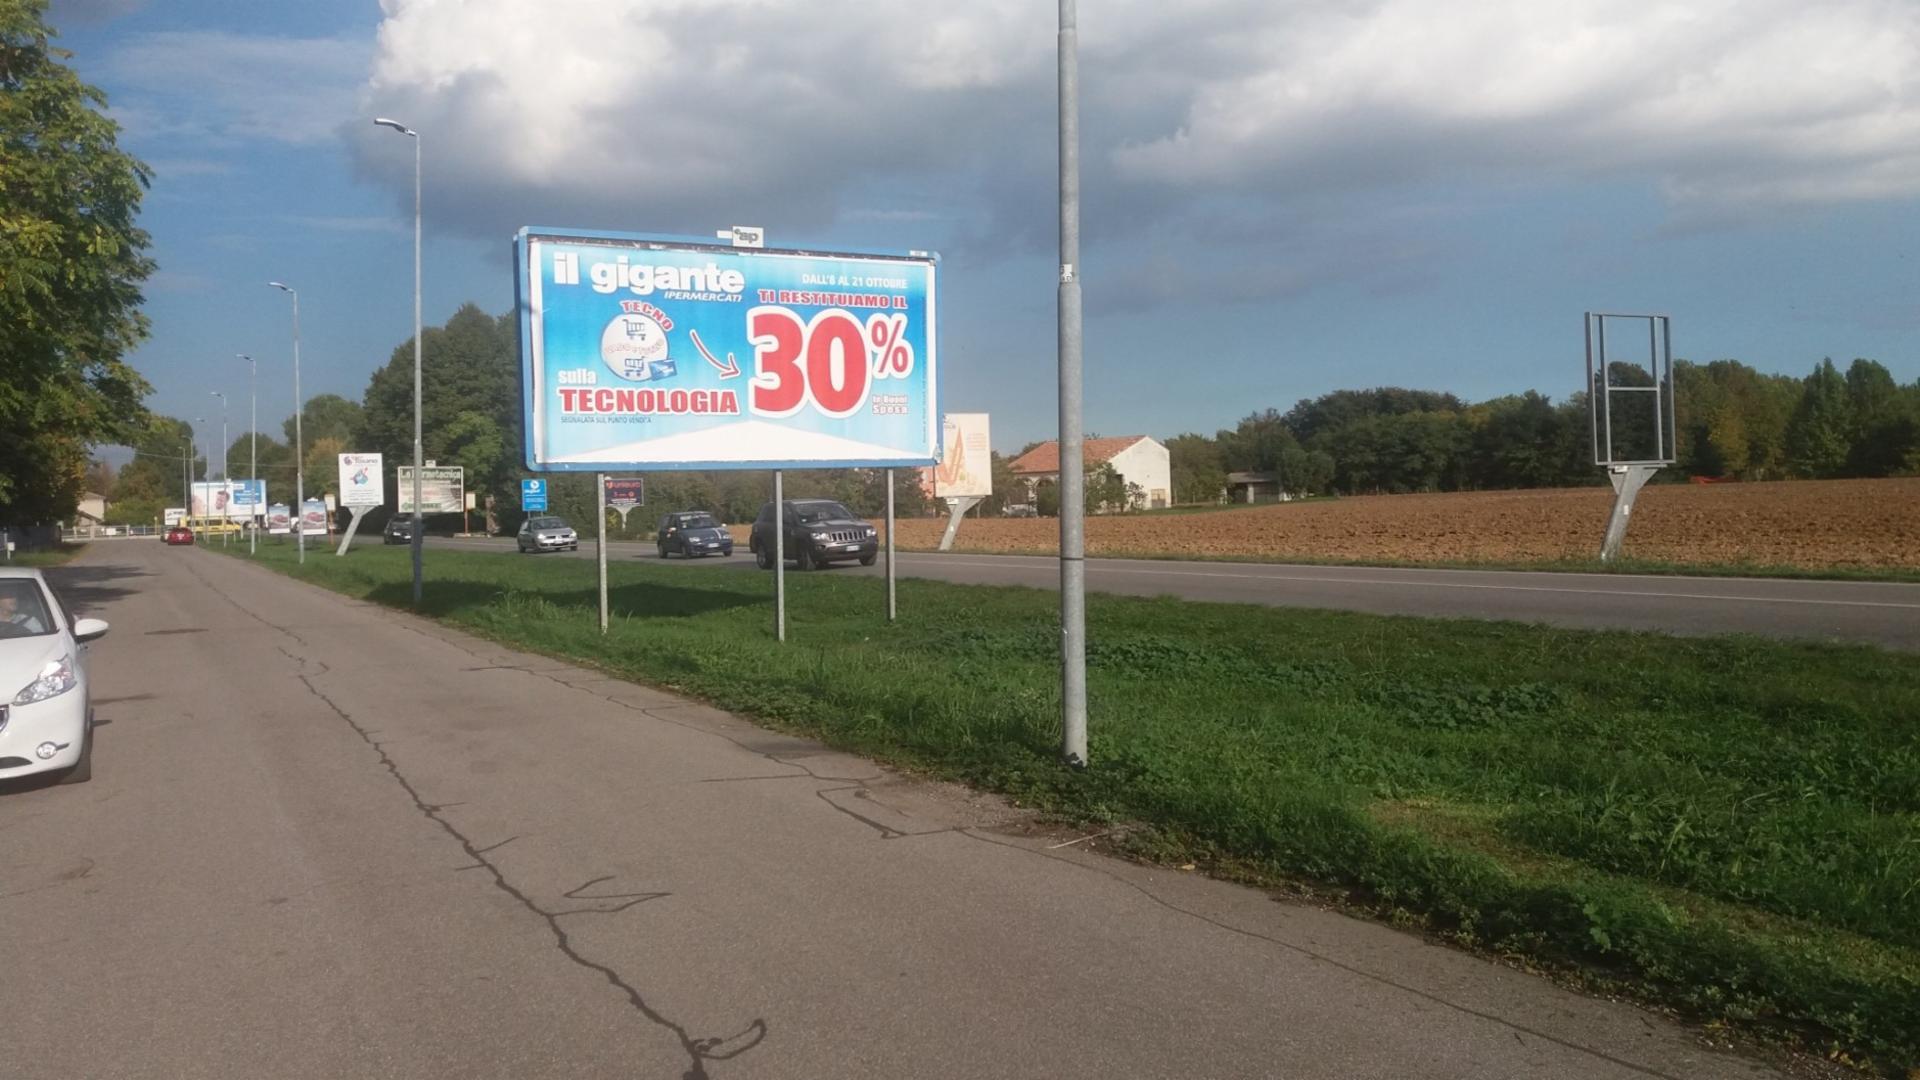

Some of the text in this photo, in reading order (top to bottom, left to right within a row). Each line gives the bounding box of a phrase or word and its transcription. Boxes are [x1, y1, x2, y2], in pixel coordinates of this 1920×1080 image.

[554, 251, 745, 295] il gigante
[838, 276, 849, 287] AL
[852, 276, 864, 287] 21
[865, 277, 908, 289] OTTOBRE
[664, 290, 743, 303] IPERMERCATI
[759, 289, 908, 309] TI RESTITUIAMO IL
[620, 300, 674, 332] TECNO
[751, 311, 909, 414] 30%
[558, 368, 597, 385] sulla
[558, 388, 740, 414] TECNOLOGIA
[607, 416, 628, 424] PUNTO
[629, 416, 652, 424] VENDITA
